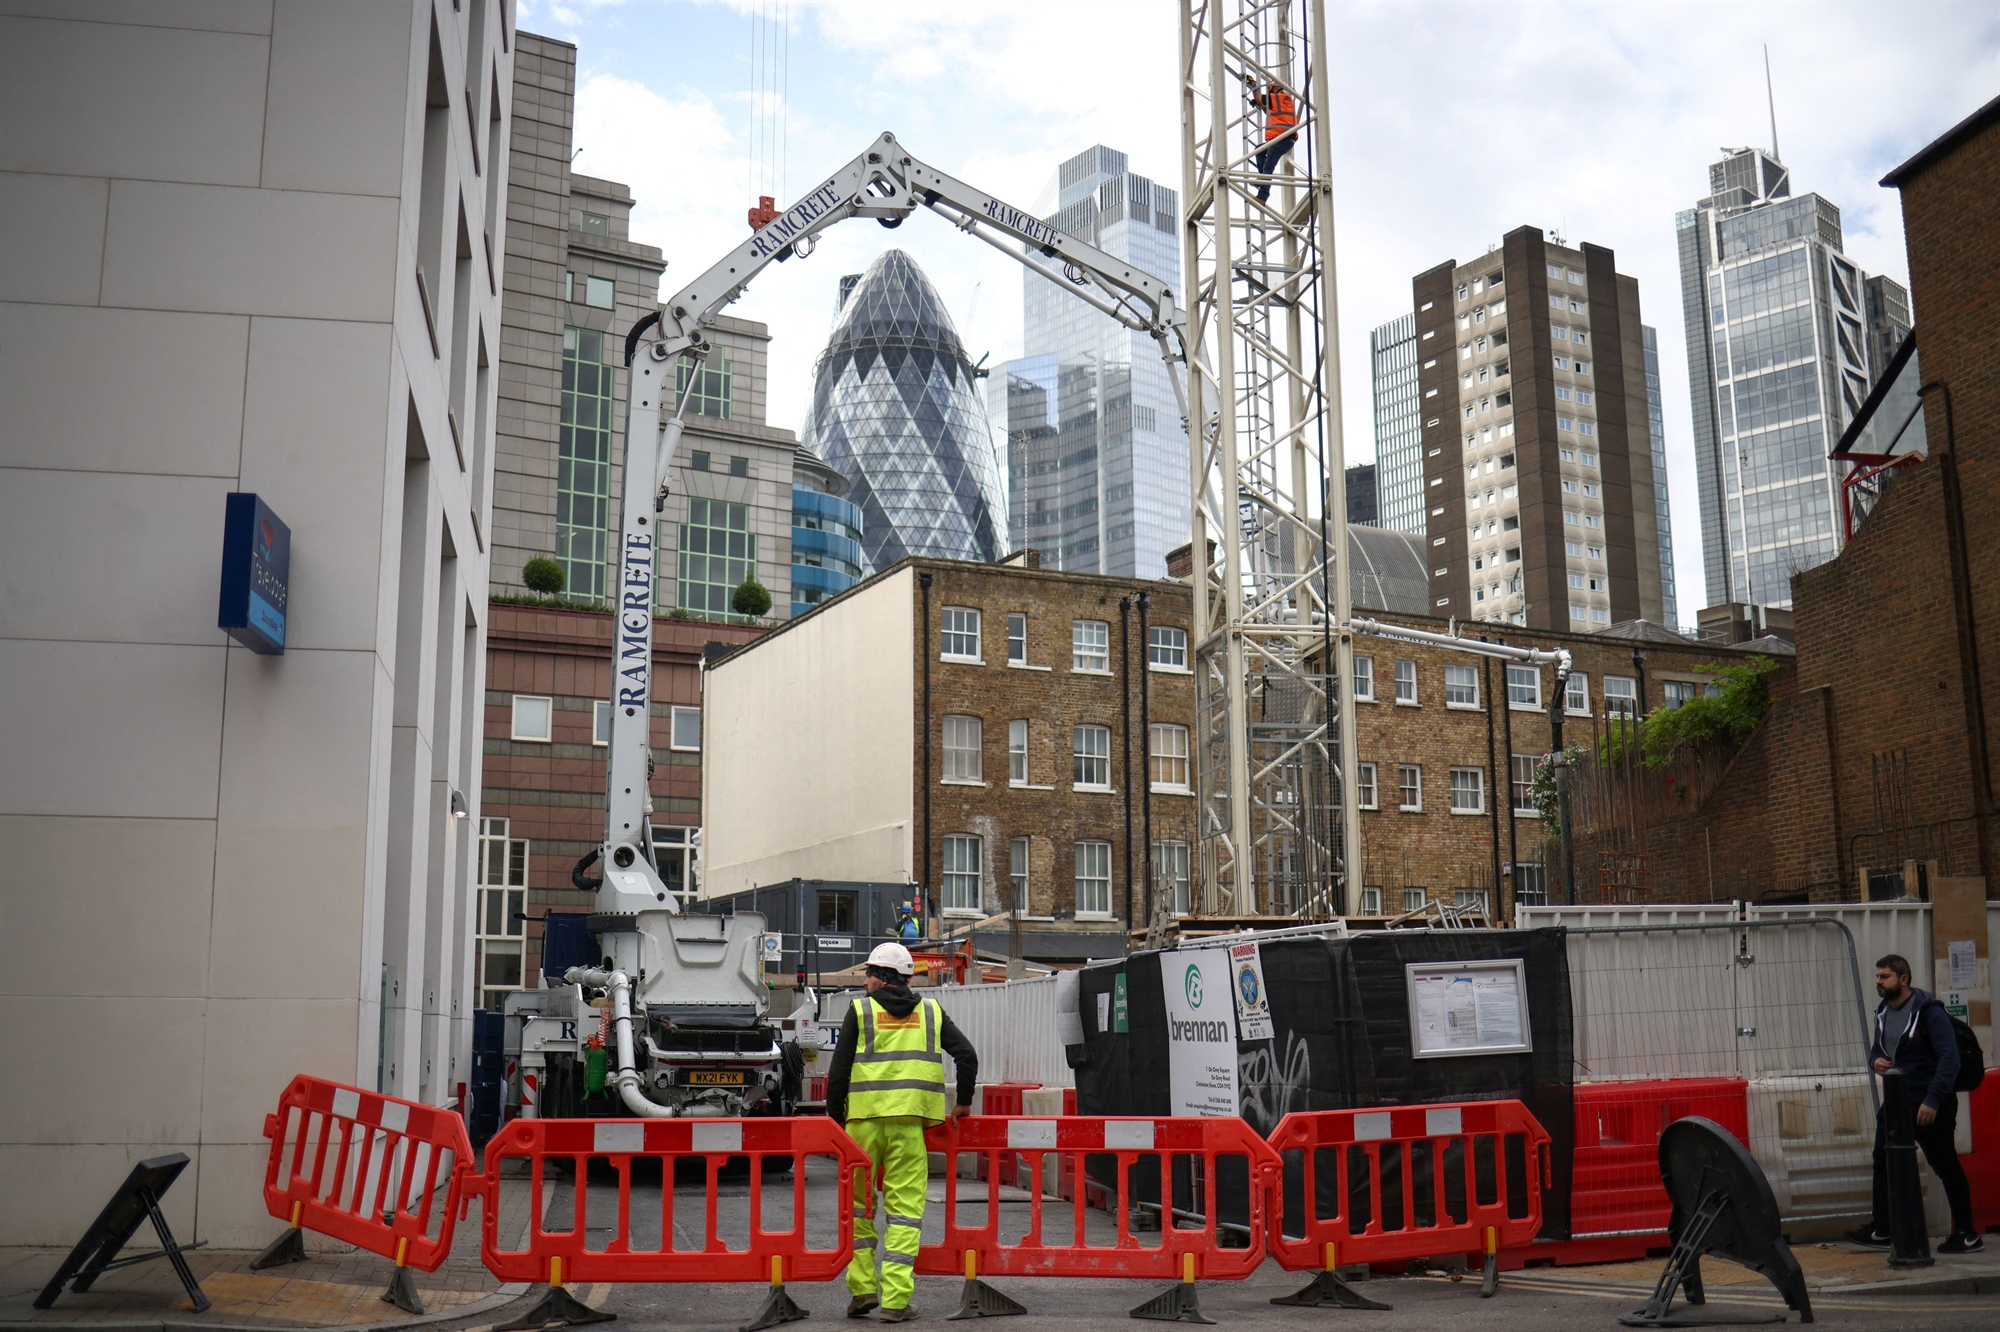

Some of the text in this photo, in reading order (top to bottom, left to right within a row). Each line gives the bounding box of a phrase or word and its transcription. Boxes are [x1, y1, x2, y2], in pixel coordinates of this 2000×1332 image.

[751, 184, 841, 258] RAMCRETE
[987, 199, 1059, 247] RAMCRETE
[253, 551, 286, 608] Travelodge
[619, 533, 652, 708] RAMCRETE
[1232, 943, 1256, 957] WARNING
[1170, 1012, 1228, 1042] brennan
[696, 1072, 738, 1083] WX21 FYK
